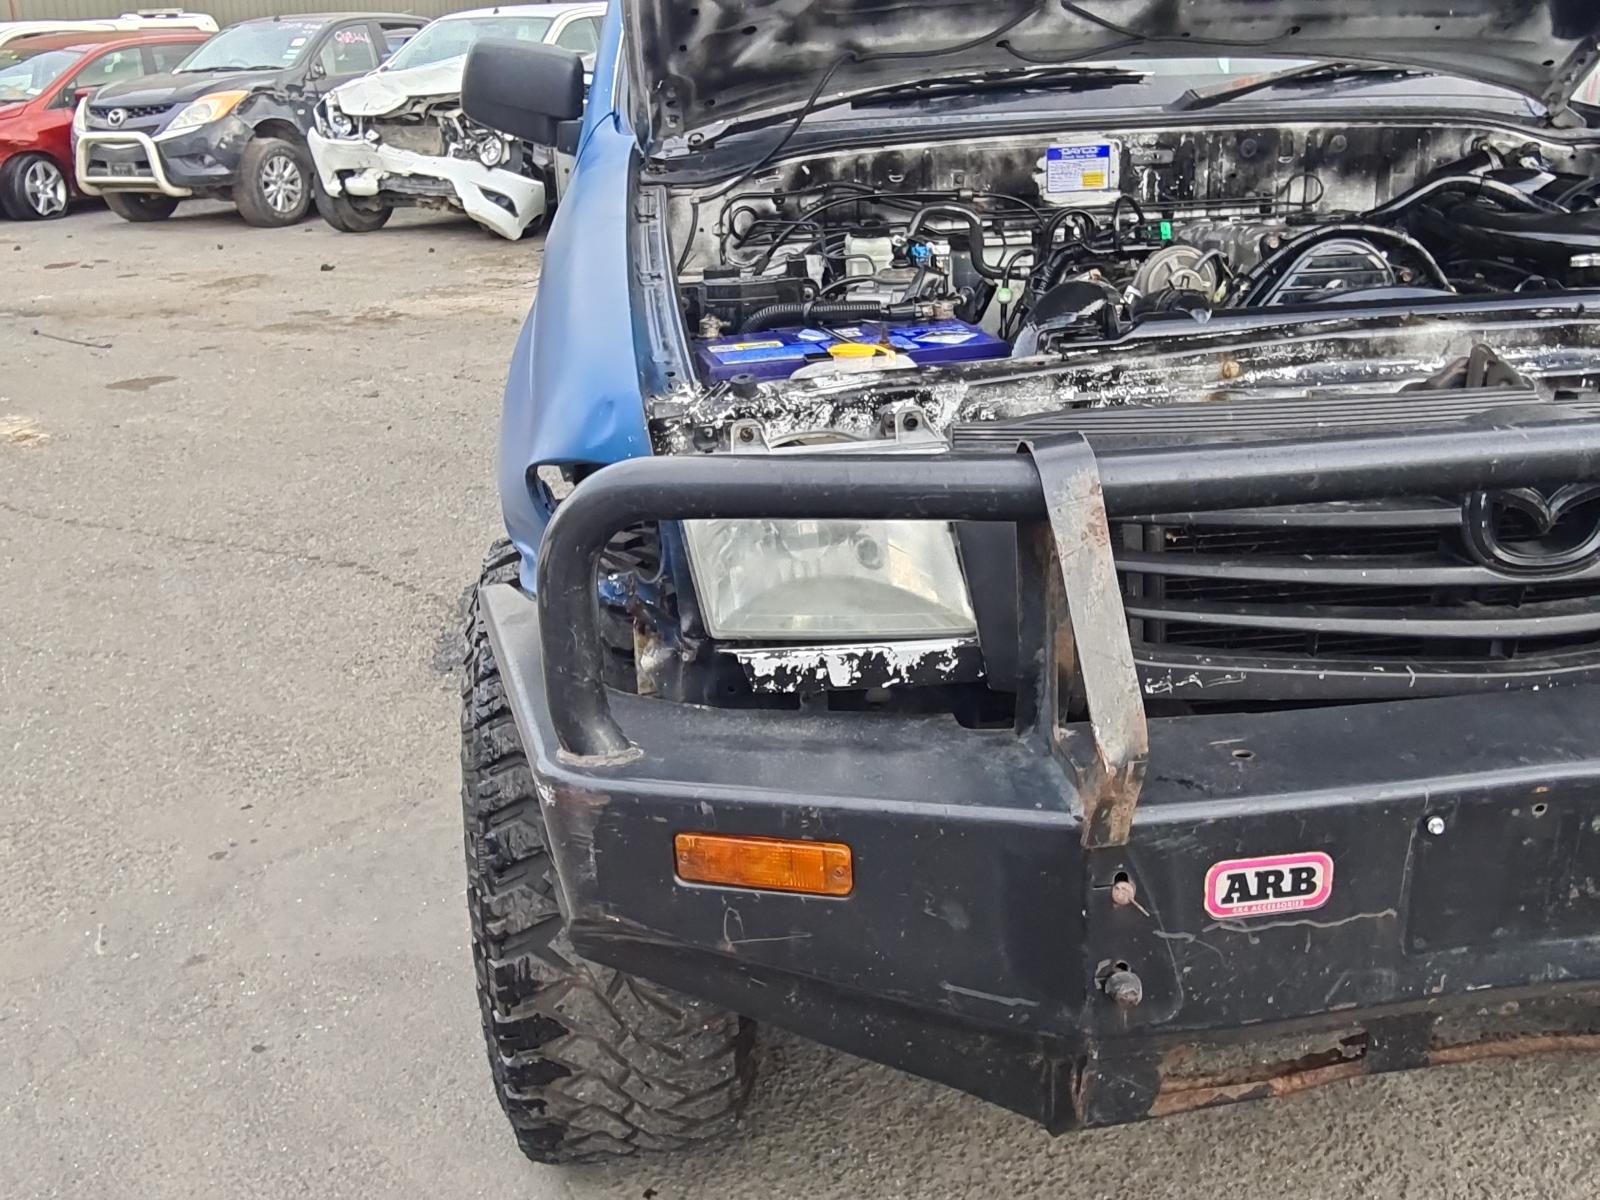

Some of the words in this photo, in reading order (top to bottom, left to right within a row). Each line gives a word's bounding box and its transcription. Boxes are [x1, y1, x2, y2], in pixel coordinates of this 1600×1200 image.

[1060, 146, 1100, 154] DAYCO
[1221, 866, 1317, 905] ARB
[1251, 900, 1305, 912] ACCESSORIES
